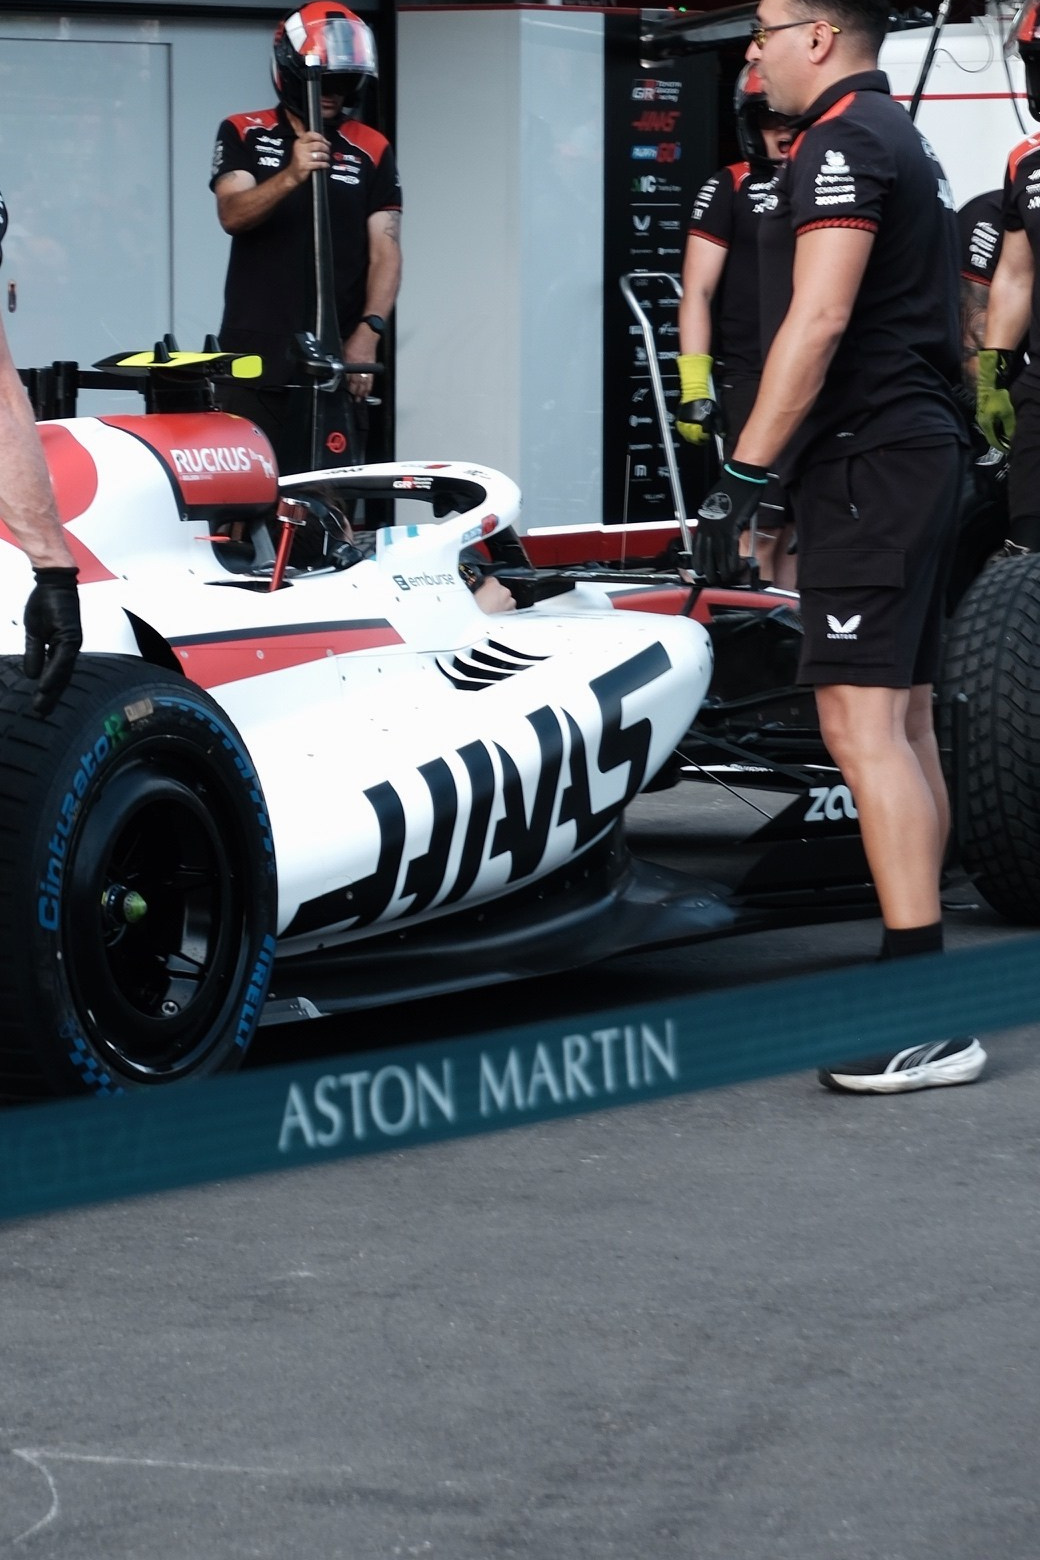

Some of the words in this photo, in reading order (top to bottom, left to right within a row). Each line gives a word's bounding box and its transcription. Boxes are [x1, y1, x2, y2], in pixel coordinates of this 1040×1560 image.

[169, 446, 252, 473] RUCKUS
[408, 571, 455, 588] emburse
[277, 640, 673, 938] HAAS
[277, 1057, 458, 1153] ASTON
[477, 1018, 681, 1120] MARTIN
